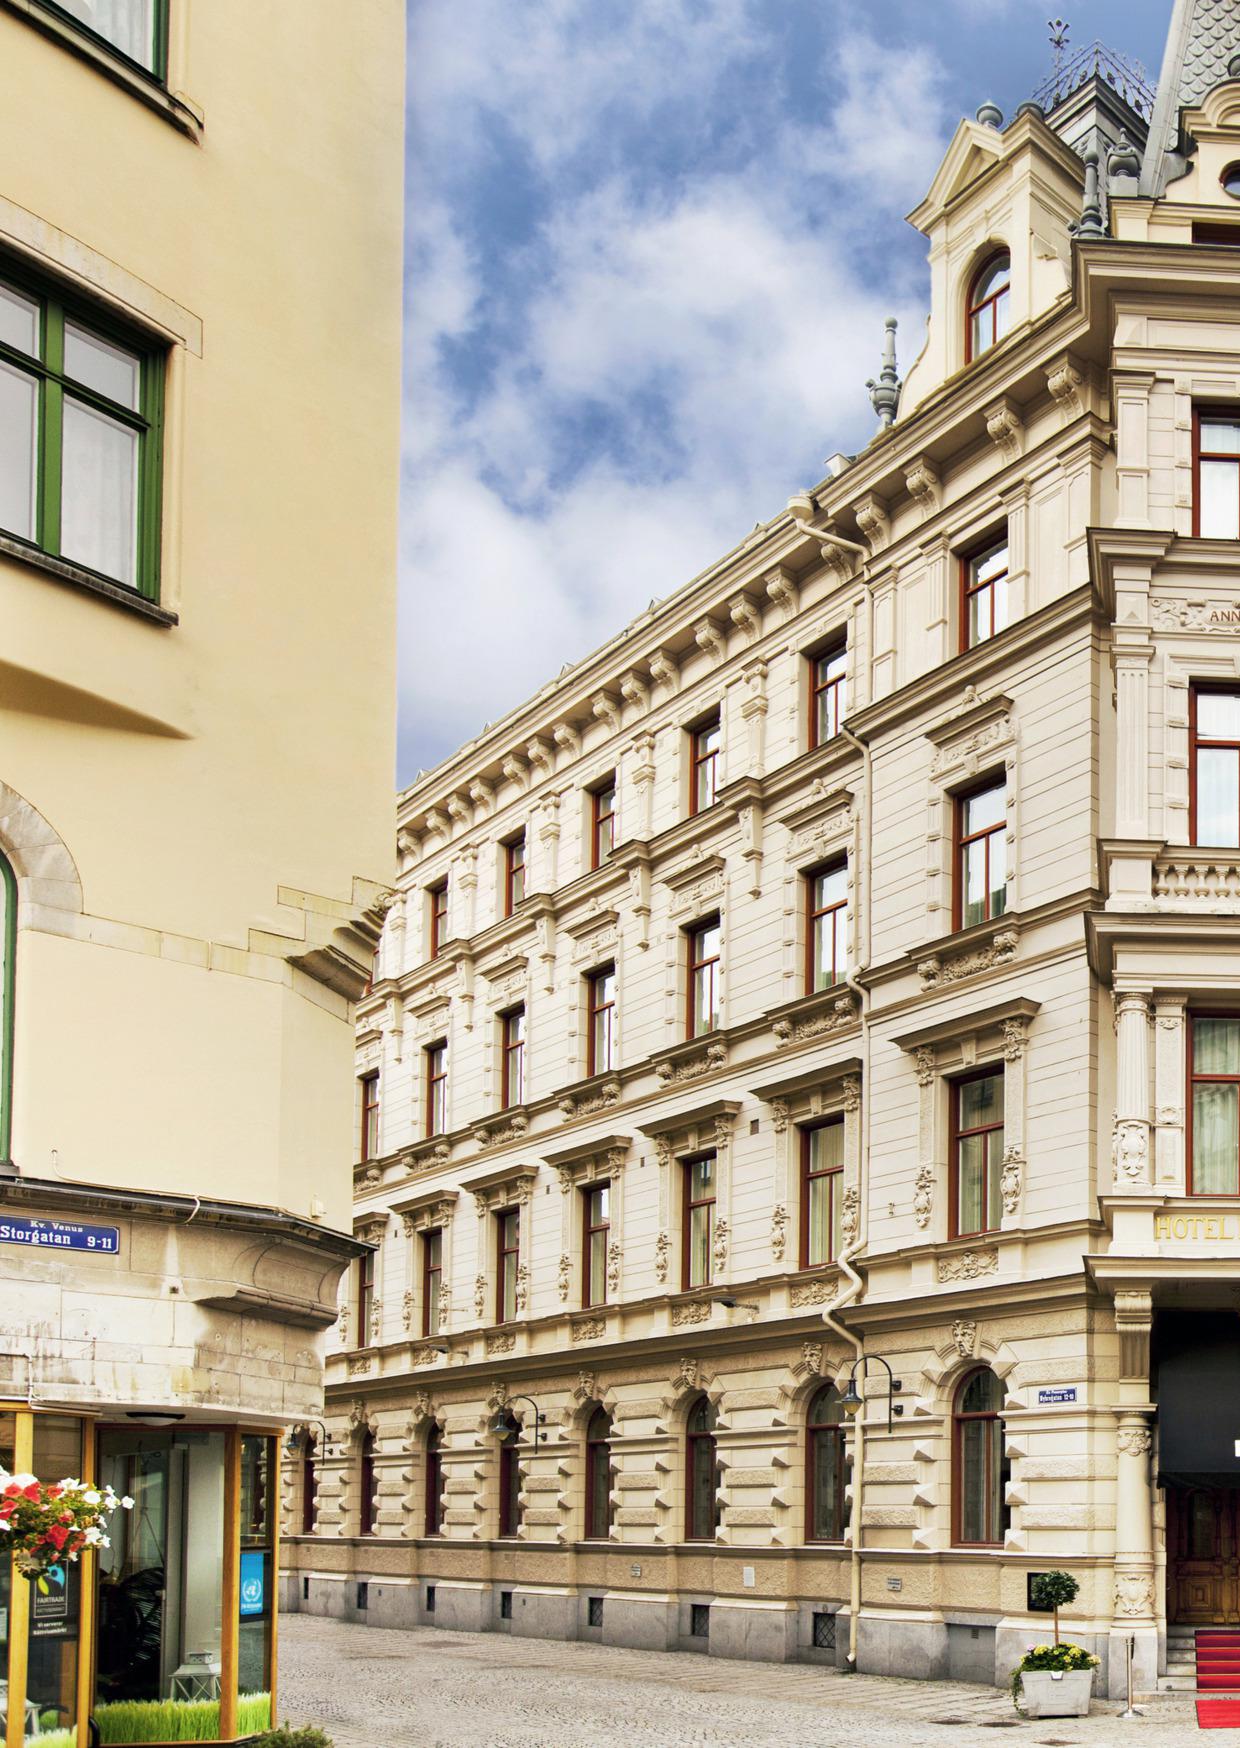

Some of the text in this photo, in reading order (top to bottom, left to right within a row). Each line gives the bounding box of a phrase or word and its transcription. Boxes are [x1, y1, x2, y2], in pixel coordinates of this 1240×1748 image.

[30, 1220, 84, 1233] Kv. Venus
[1155, 1216, 1234, 1240] HOTEL
[0, 1225, 112, 1249] Storgatan 9-11
[36, 1596, 65, 1604] FAIRTRADE
